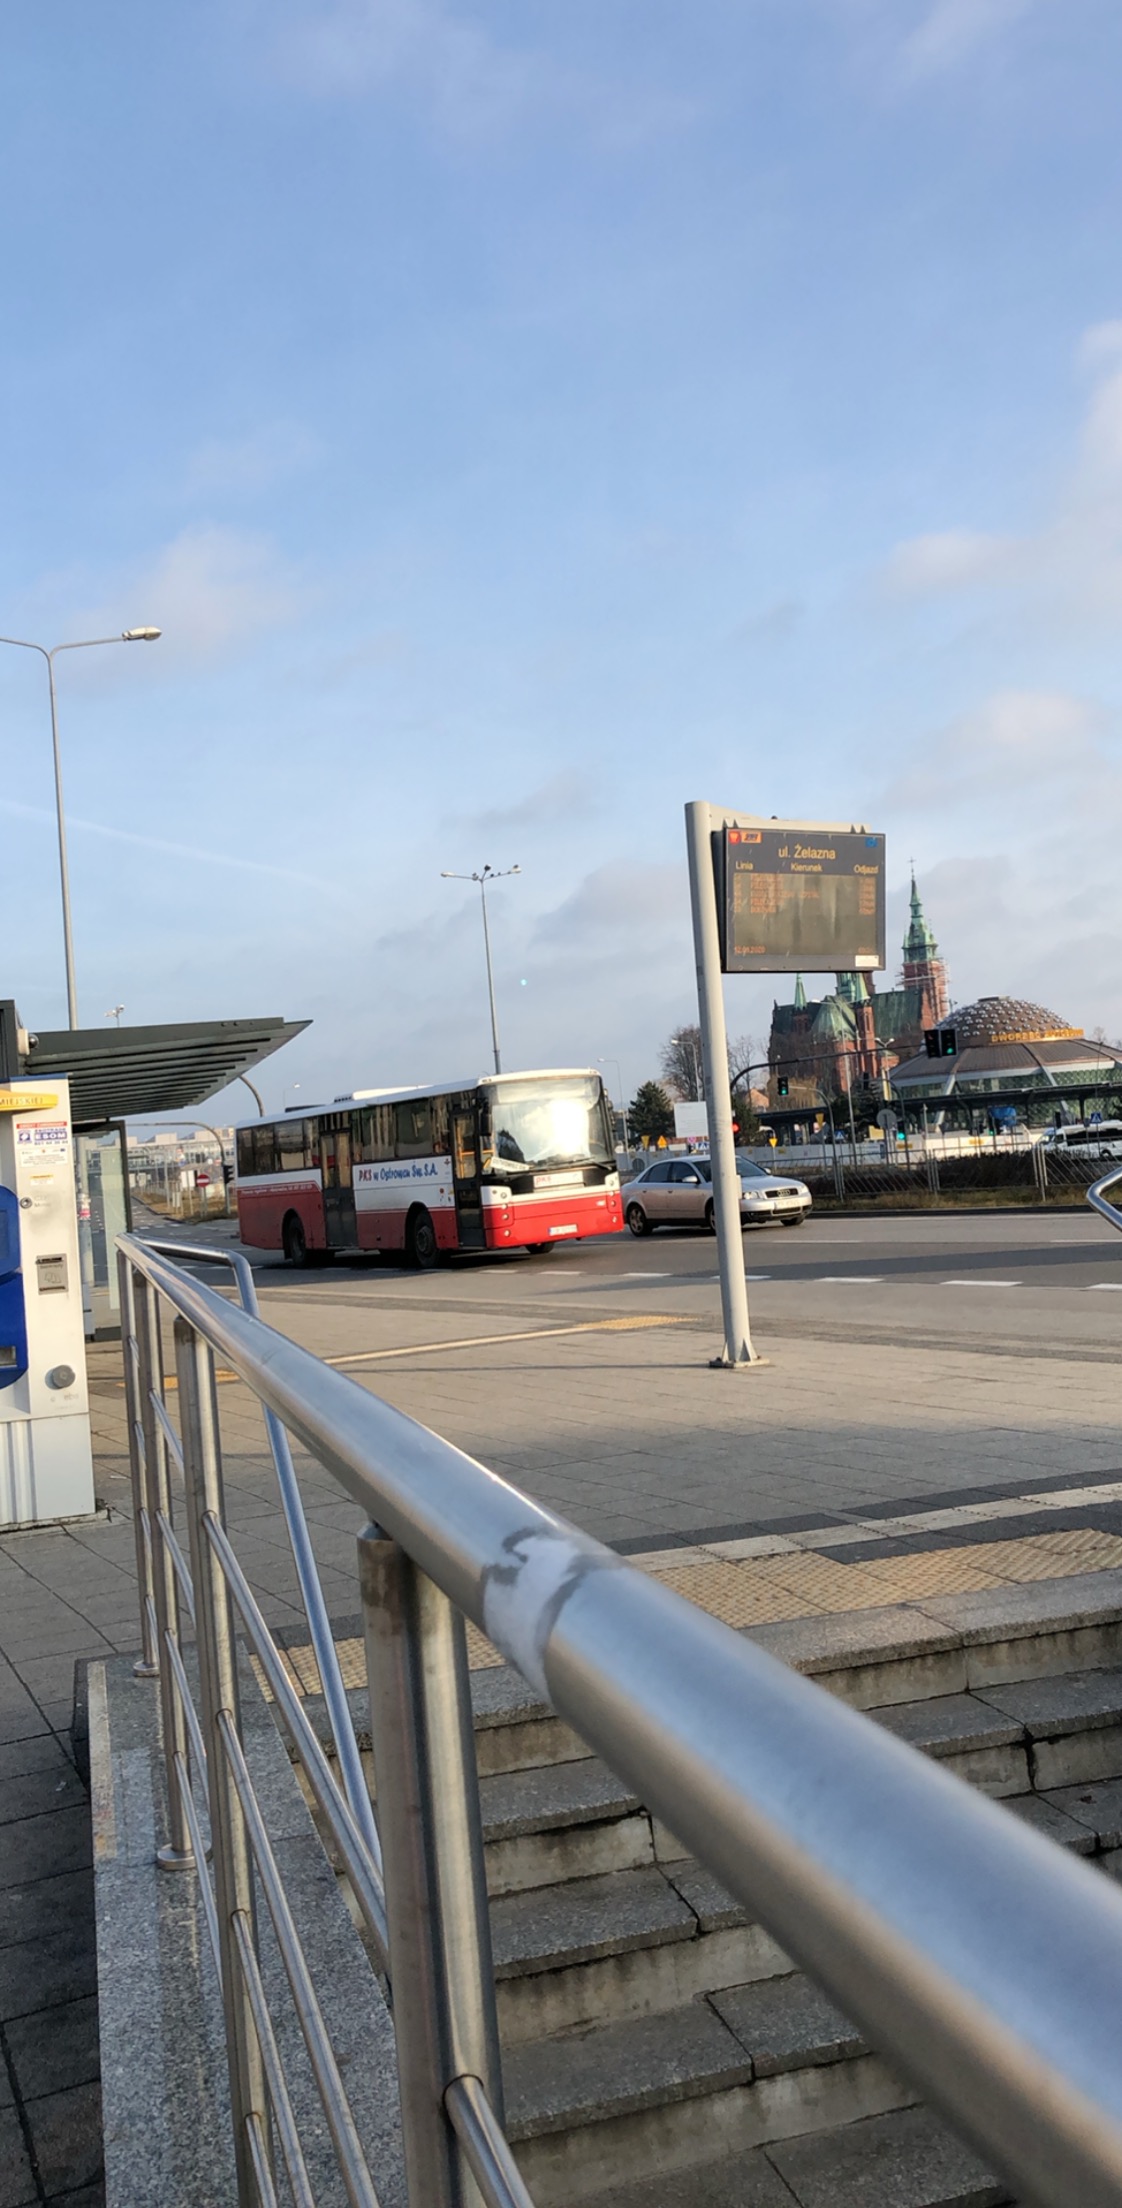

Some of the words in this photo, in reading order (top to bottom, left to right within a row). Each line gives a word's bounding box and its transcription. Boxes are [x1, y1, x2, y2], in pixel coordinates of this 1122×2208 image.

[778, 845, 791, 858] ul.
[794, 843, 836, 860] Żelazna
[735, 861, 753, 871] Linia
[790, 862, 823, 873] Kierunek
[853, 864, 879, 875] Odjazd
[358, 1169, 372, 1182] PKS
